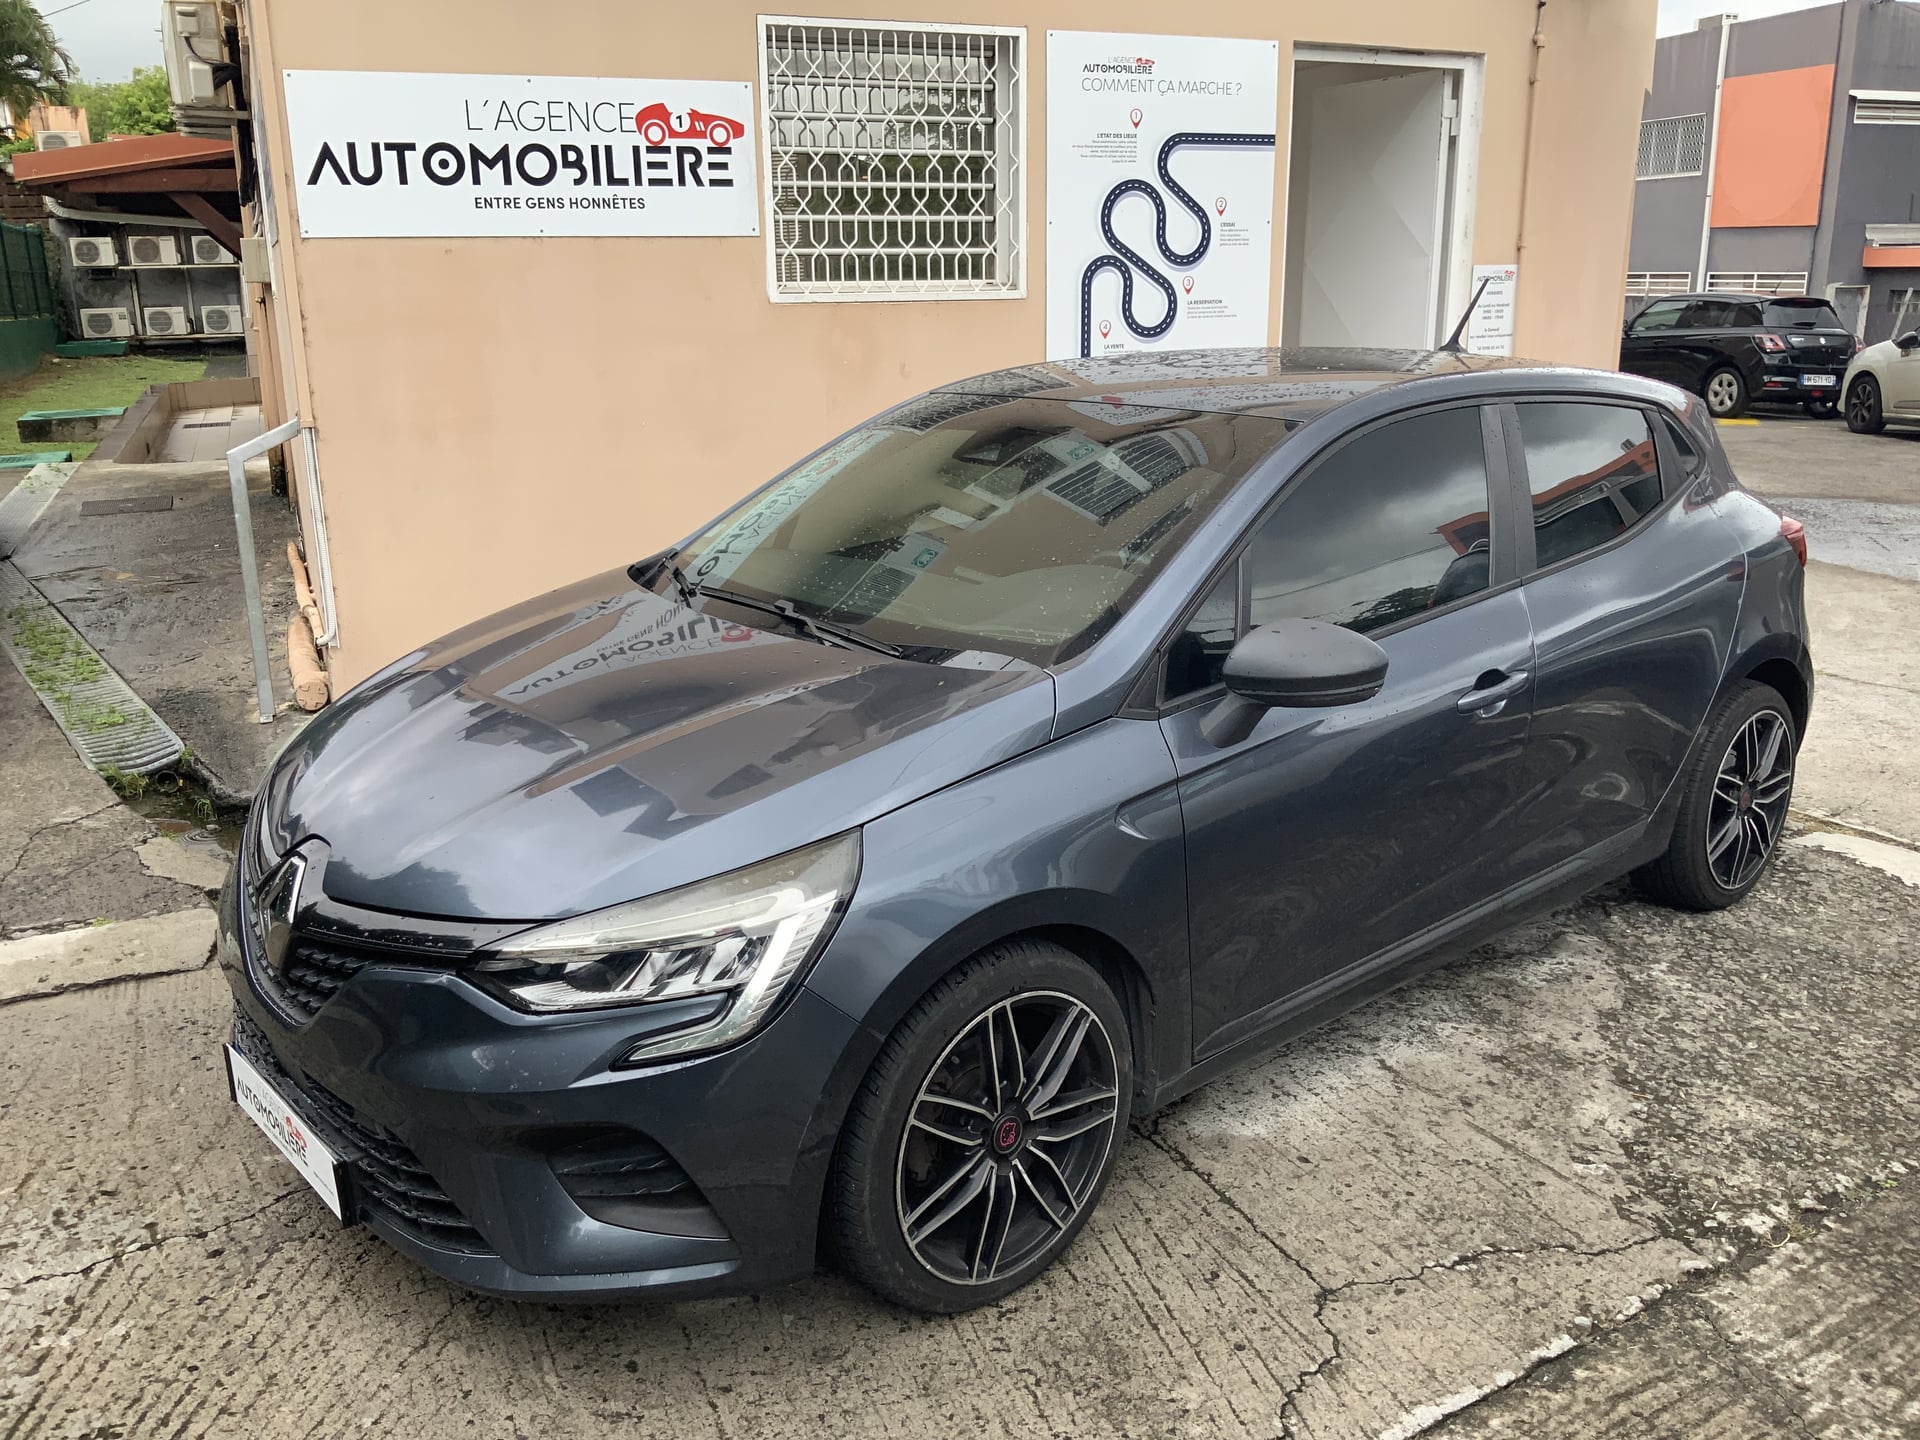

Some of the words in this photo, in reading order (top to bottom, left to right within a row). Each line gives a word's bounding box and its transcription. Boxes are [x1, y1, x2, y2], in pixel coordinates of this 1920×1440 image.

[1081, 77, 1155, 93] COMMENT
[1157, 80, 1175, 96] ÇA
[1177, 80, 1233, 95] MARCHE
[465, 99, 638, 133] L'AGENCE
[675, 114, 683, 128] 1
[306, 141, 735, 188] AUTOMOBILIERE
[474, 196, 521, 209] ENTRE
[525, 196, 565, 209] GENS
[569, 193, 646, 210] HONNÊTES
[1218, 200, 1224, 208] 2
[1185, 278, 1191, 287] 3
